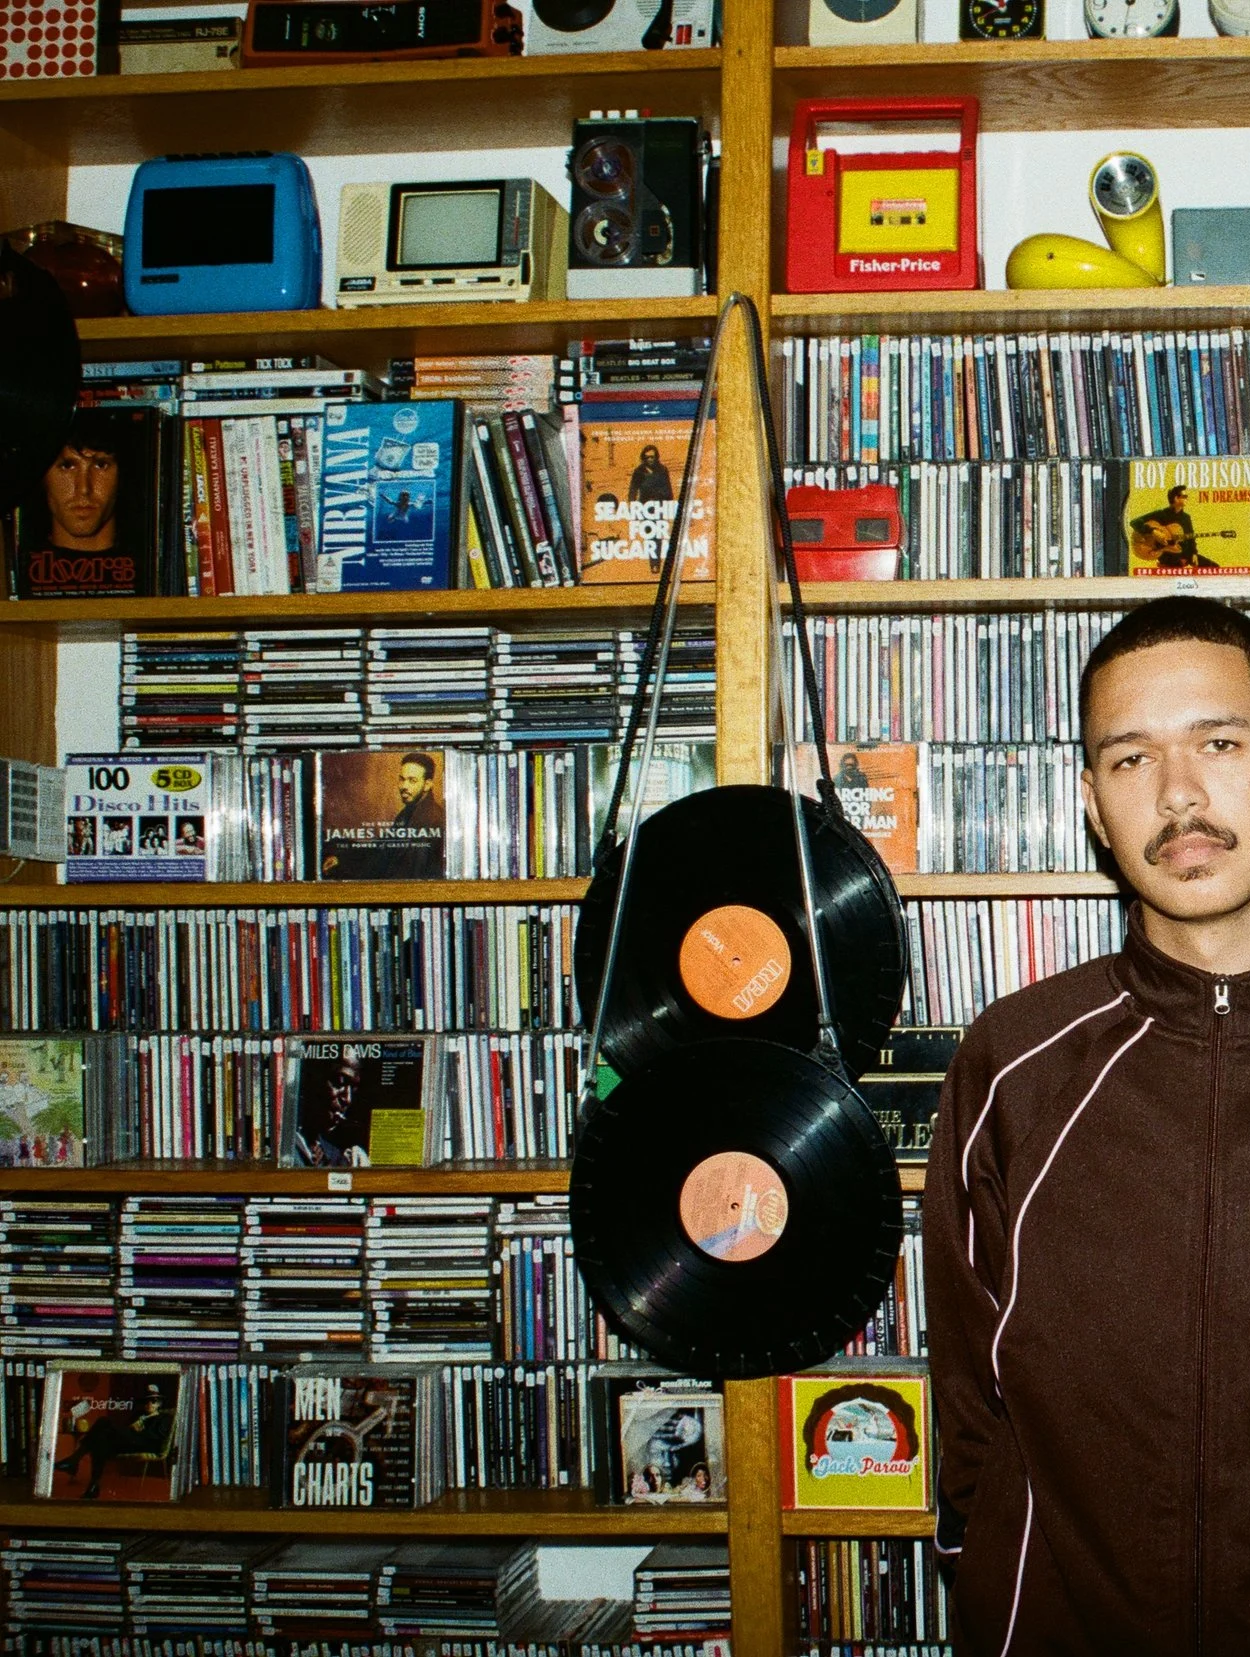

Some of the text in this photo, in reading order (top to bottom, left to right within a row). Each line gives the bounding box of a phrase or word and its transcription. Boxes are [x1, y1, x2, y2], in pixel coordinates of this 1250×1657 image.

[418, 6, 426, 38] SONY
[850, 258, 941, 273] Fisher-Price
[256, 358, 292, 369] TICK TOCK
[660, 358, 676, 366] BOX
[192, 426, 202, 472] KANGAROO
[1134, 462, 1168, 489] ROY
[322, 426, 371, 568] NIRVANA
[1198, 490, 1209, 503] IN
[628, 520, 671, 540] FOR
[590, 538, 658, 561] SUGAR
[1137, 568, 1152, 576] THE
[88, 766, 171, 790] 100 5
[172, 769, 192, 780] CD
[73, 794, 200, 812] Disco Hits
[862, 815, 897, 830] MAN
[324, 827, 442, 842] JAMES INGRAM
[732, 959, 784, 1012] RCA
[301, 1044, 382, 1060] MILES DAVIS
[880, 1050, 894, 1065] II
[692, 1380, 712, 1388] FLACK
[90, 1396, 134, 1410] barbieri
[294, 1378, 341, 1420] MEN
[293, 1462, 374, 1506] CHARTS
